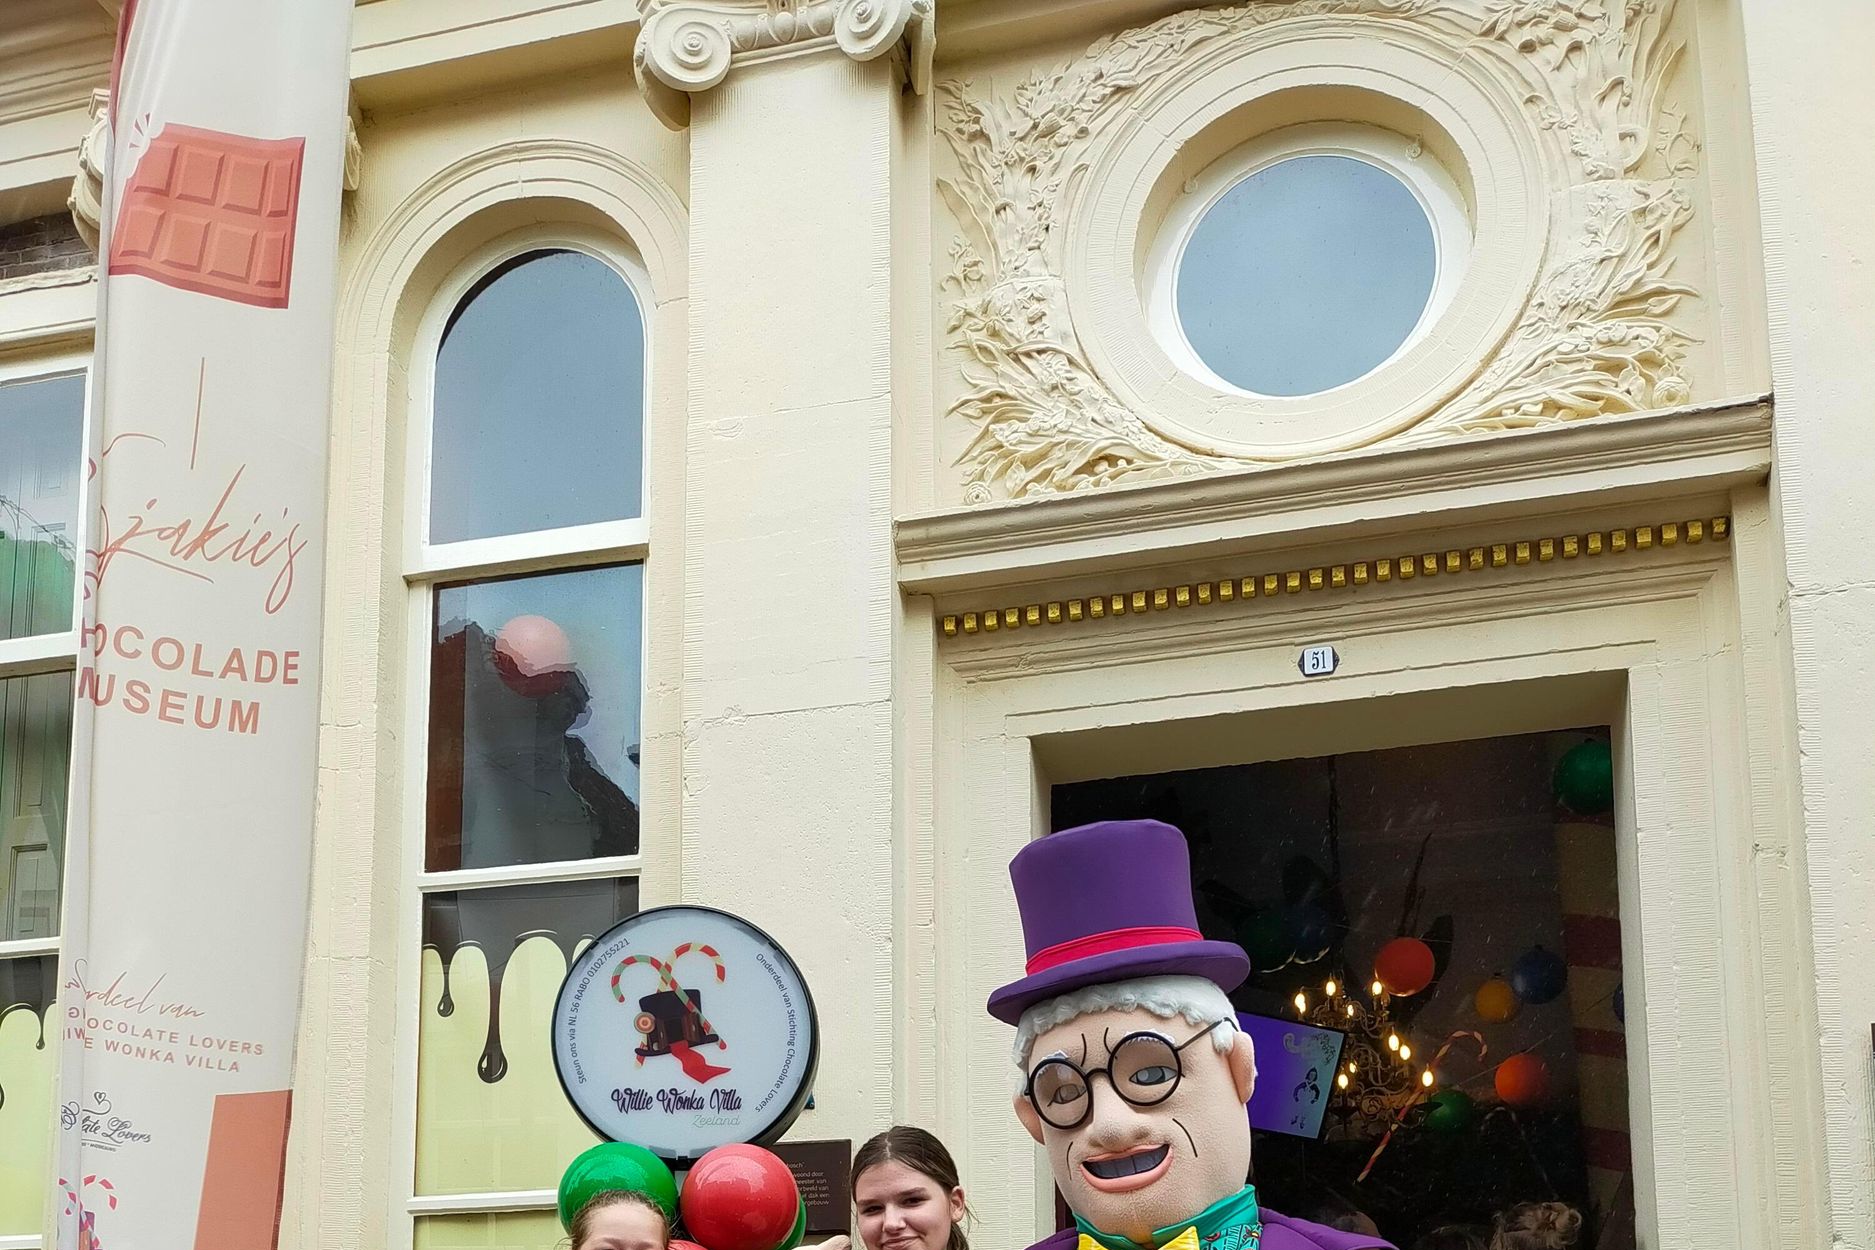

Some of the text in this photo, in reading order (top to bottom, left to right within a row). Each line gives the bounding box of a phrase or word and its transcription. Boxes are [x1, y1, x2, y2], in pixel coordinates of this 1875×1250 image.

[1312, 650, 1326, 669] 51
[159, 1002, 207, 1018] van
[568, 937, 631, 1085] Steun ons via NL 56 RABO 0102755221
[86, 1016, 180, 1044] OCOLATE
[189, 1034, 265, 1056] LOVERS
[755, 953, 798, 1113] Onderdeel van Stichting Chocolate Lovers
[104, 1039, 241, 1073] WONKA VILLA
[610, 1087, 743, 1115] Willie Wonka Villa
[101, 1116, 152, 1145] Lovers
[692, 1114, 741, 1129] Zeeland
